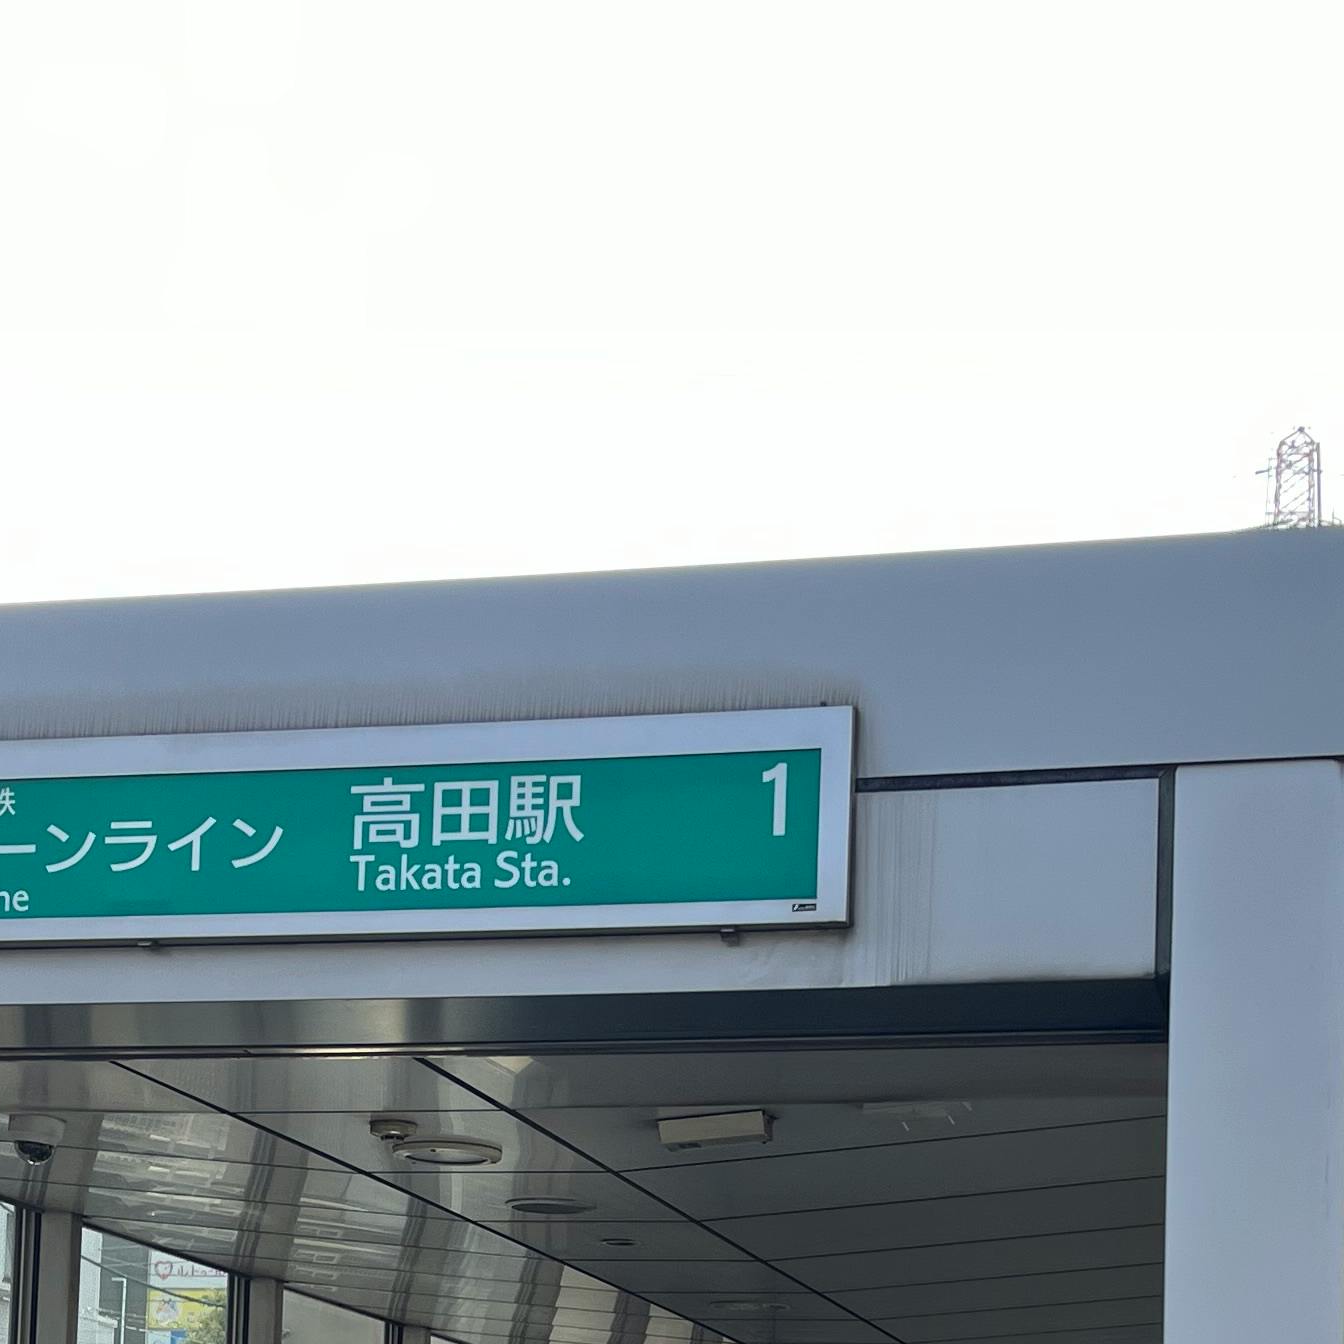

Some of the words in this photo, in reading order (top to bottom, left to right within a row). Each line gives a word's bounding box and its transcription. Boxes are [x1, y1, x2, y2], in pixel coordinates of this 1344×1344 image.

[350, 774, 585, 851] 高田駅
[761, 761, 789, 837] 1
[350, 853, 482, 892] Takata
[493, 850, 572, 888] Sta.
